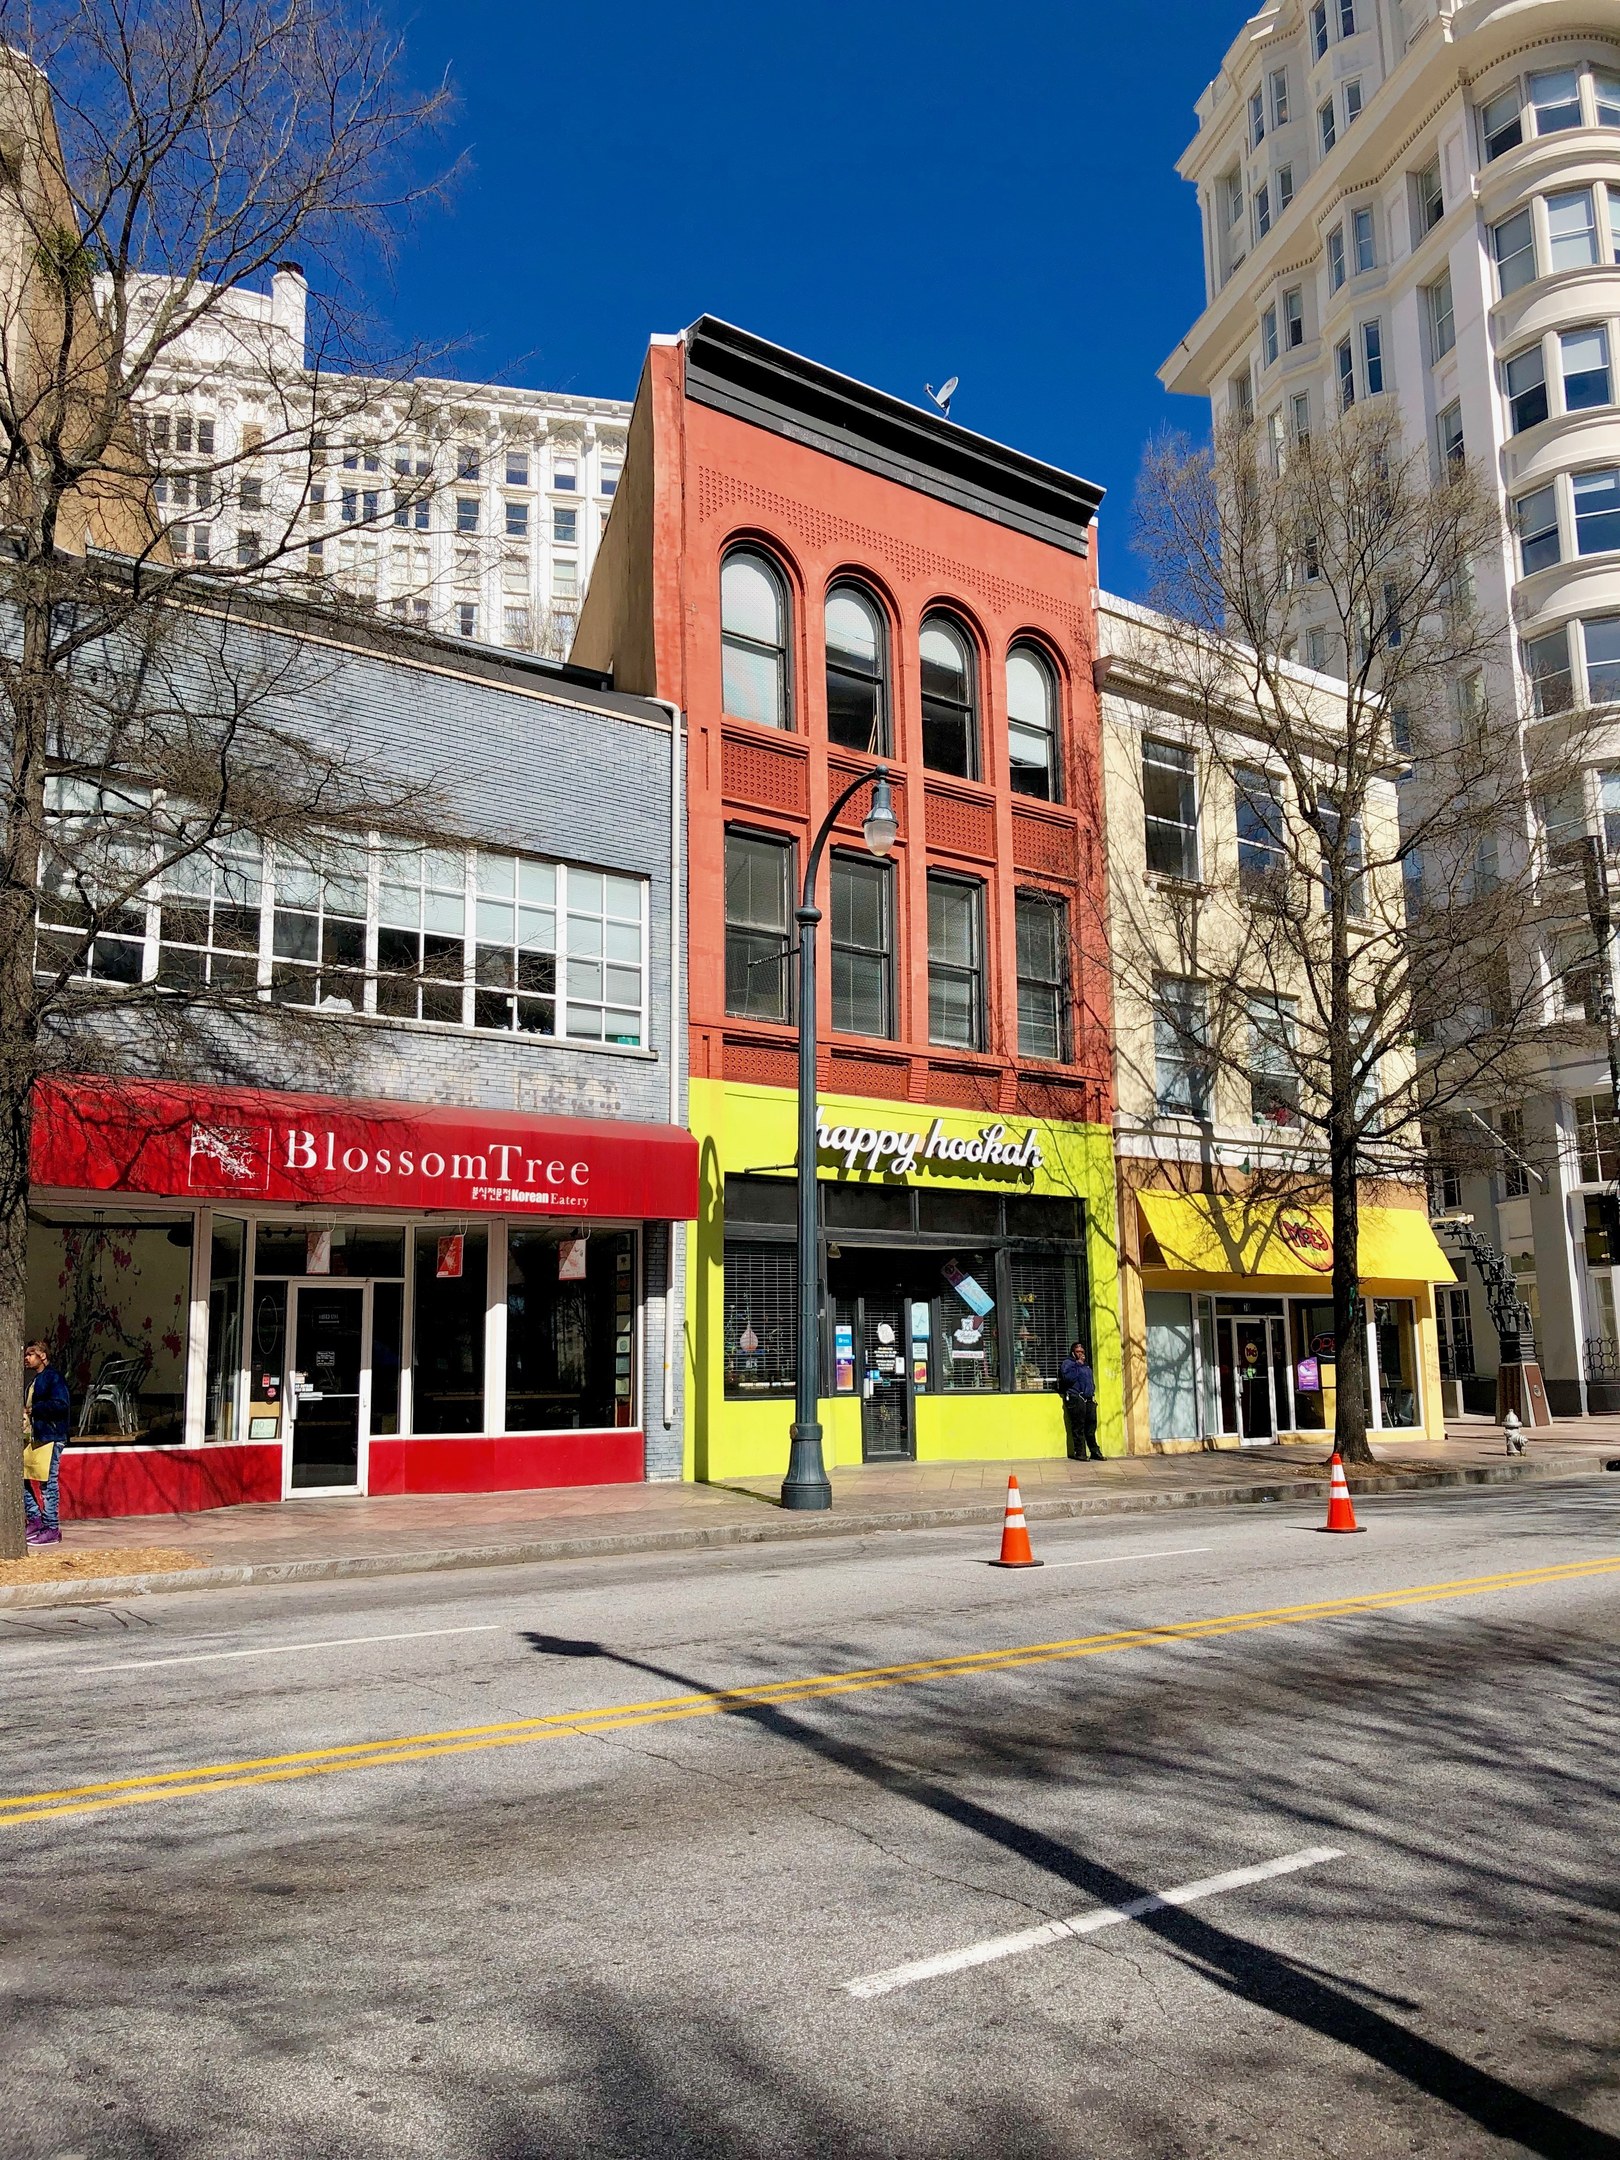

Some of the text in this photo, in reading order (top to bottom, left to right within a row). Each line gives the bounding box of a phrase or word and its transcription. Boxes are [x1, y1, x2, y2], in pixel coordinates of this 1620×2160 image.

[816, 1105, 1044, 1175] happy hookah
[511, 1188, 549, 1204] Korean
[550, 1192, 589, 1208] Eatery
